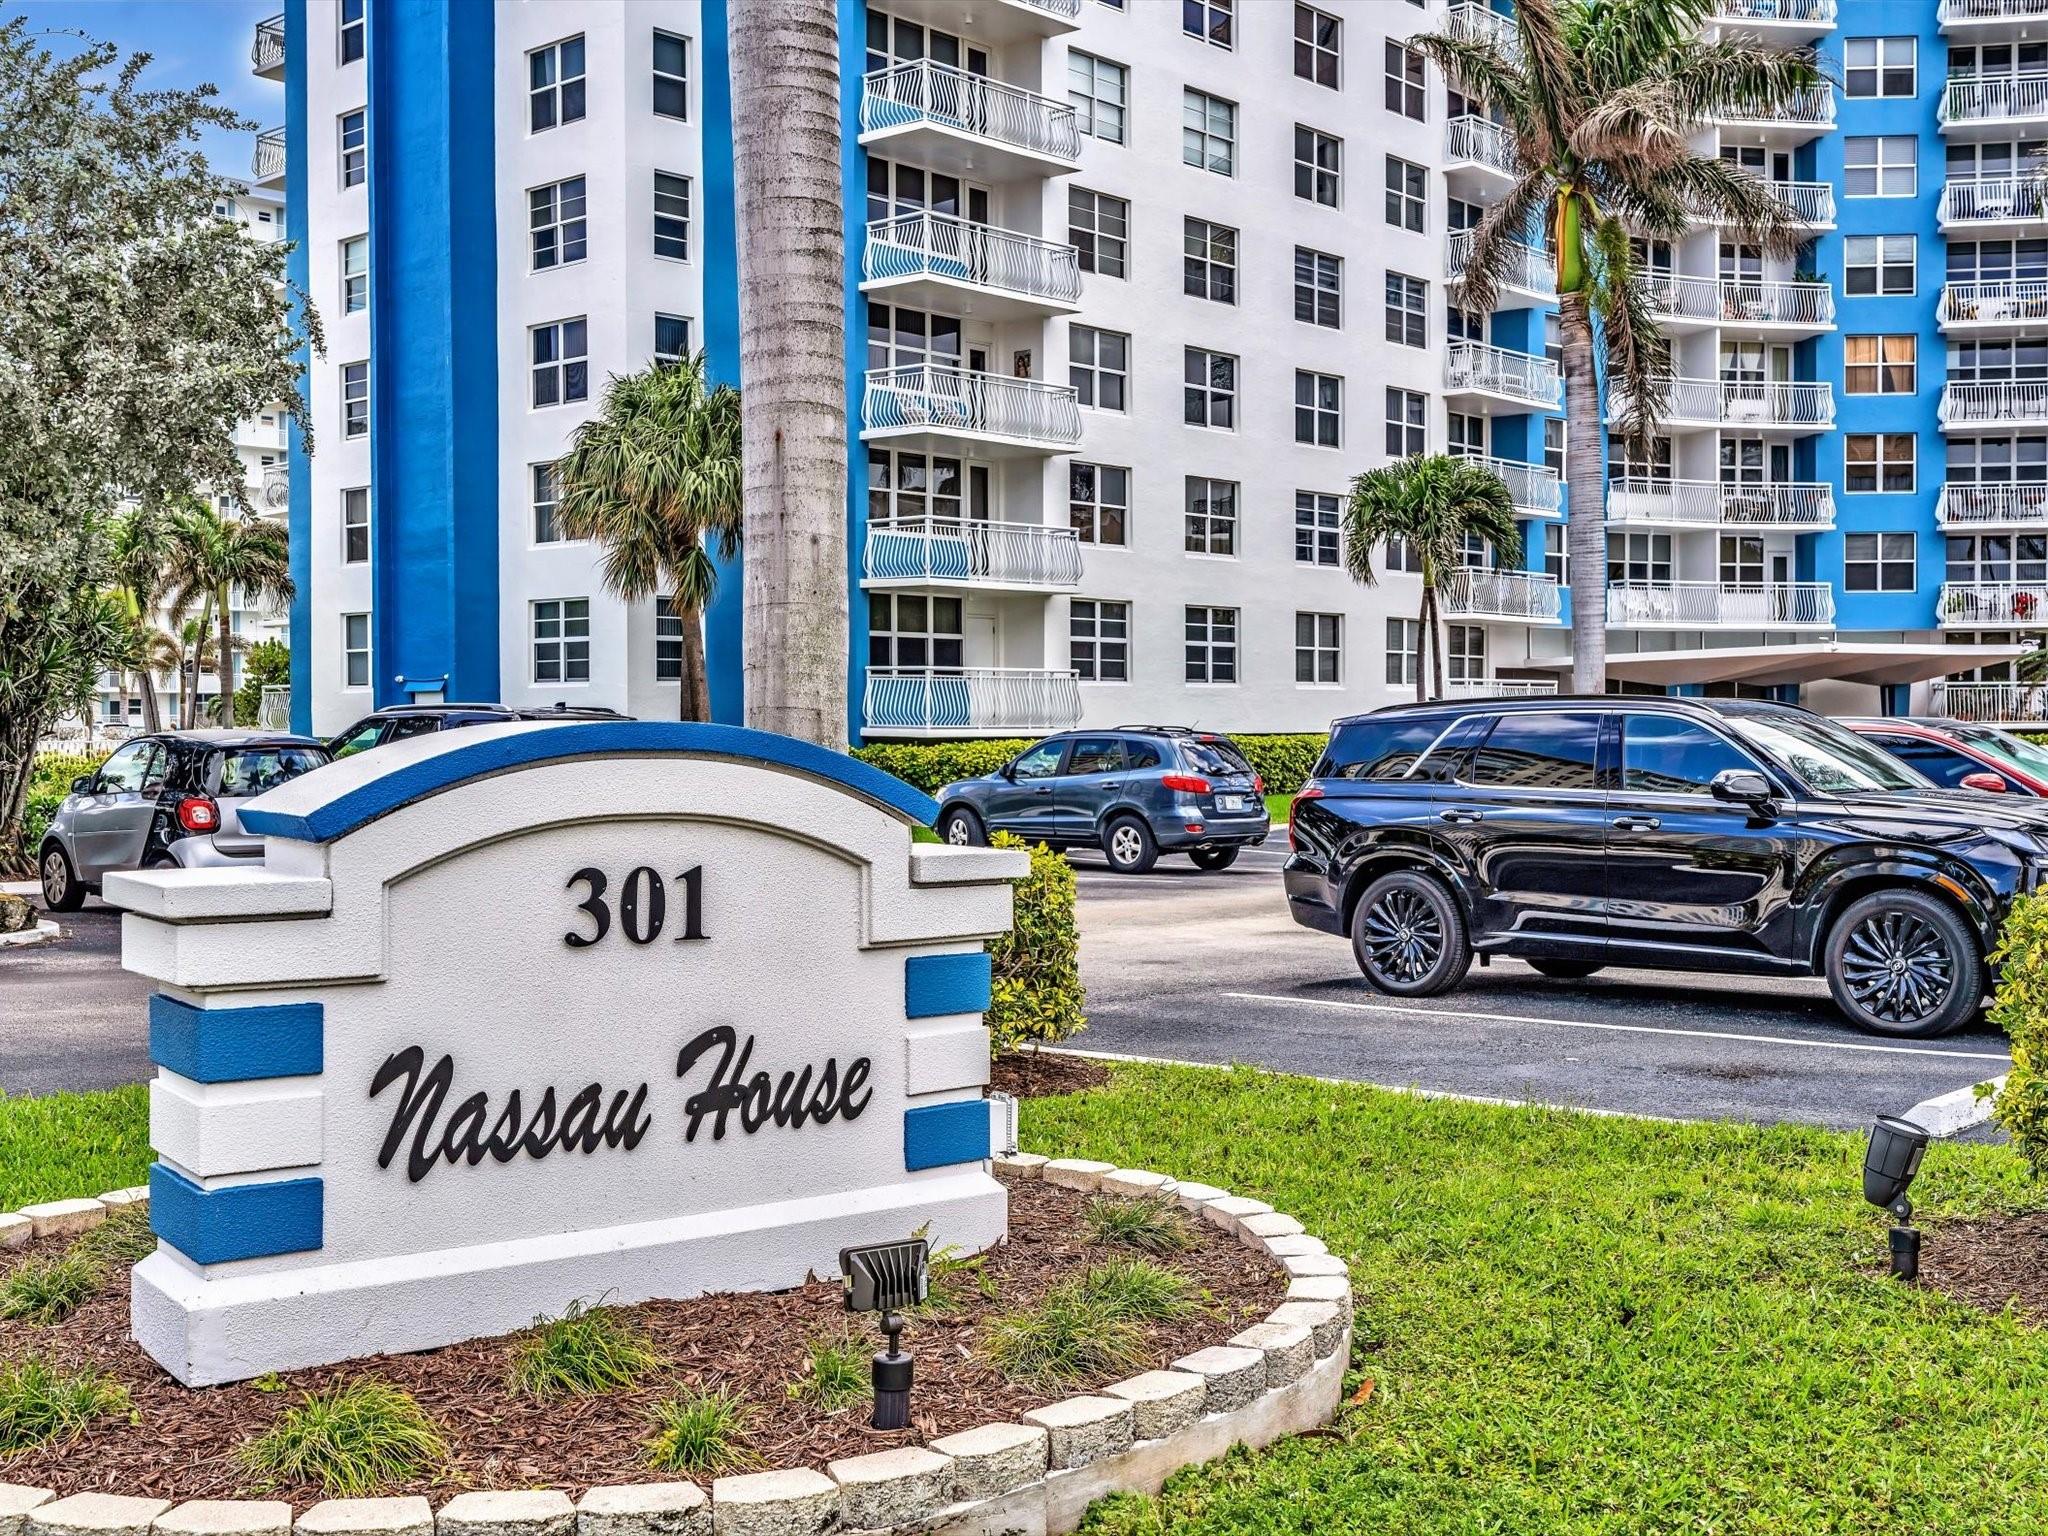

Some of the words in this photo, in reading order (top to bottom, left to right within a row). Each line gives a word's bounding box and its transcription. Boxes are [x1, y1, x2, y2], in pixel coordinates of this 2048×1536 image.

[564, 864, 712, 948] 301
[369, 1045, 652, 1184] Nassau
[676, 1025, 873, 1143] House
